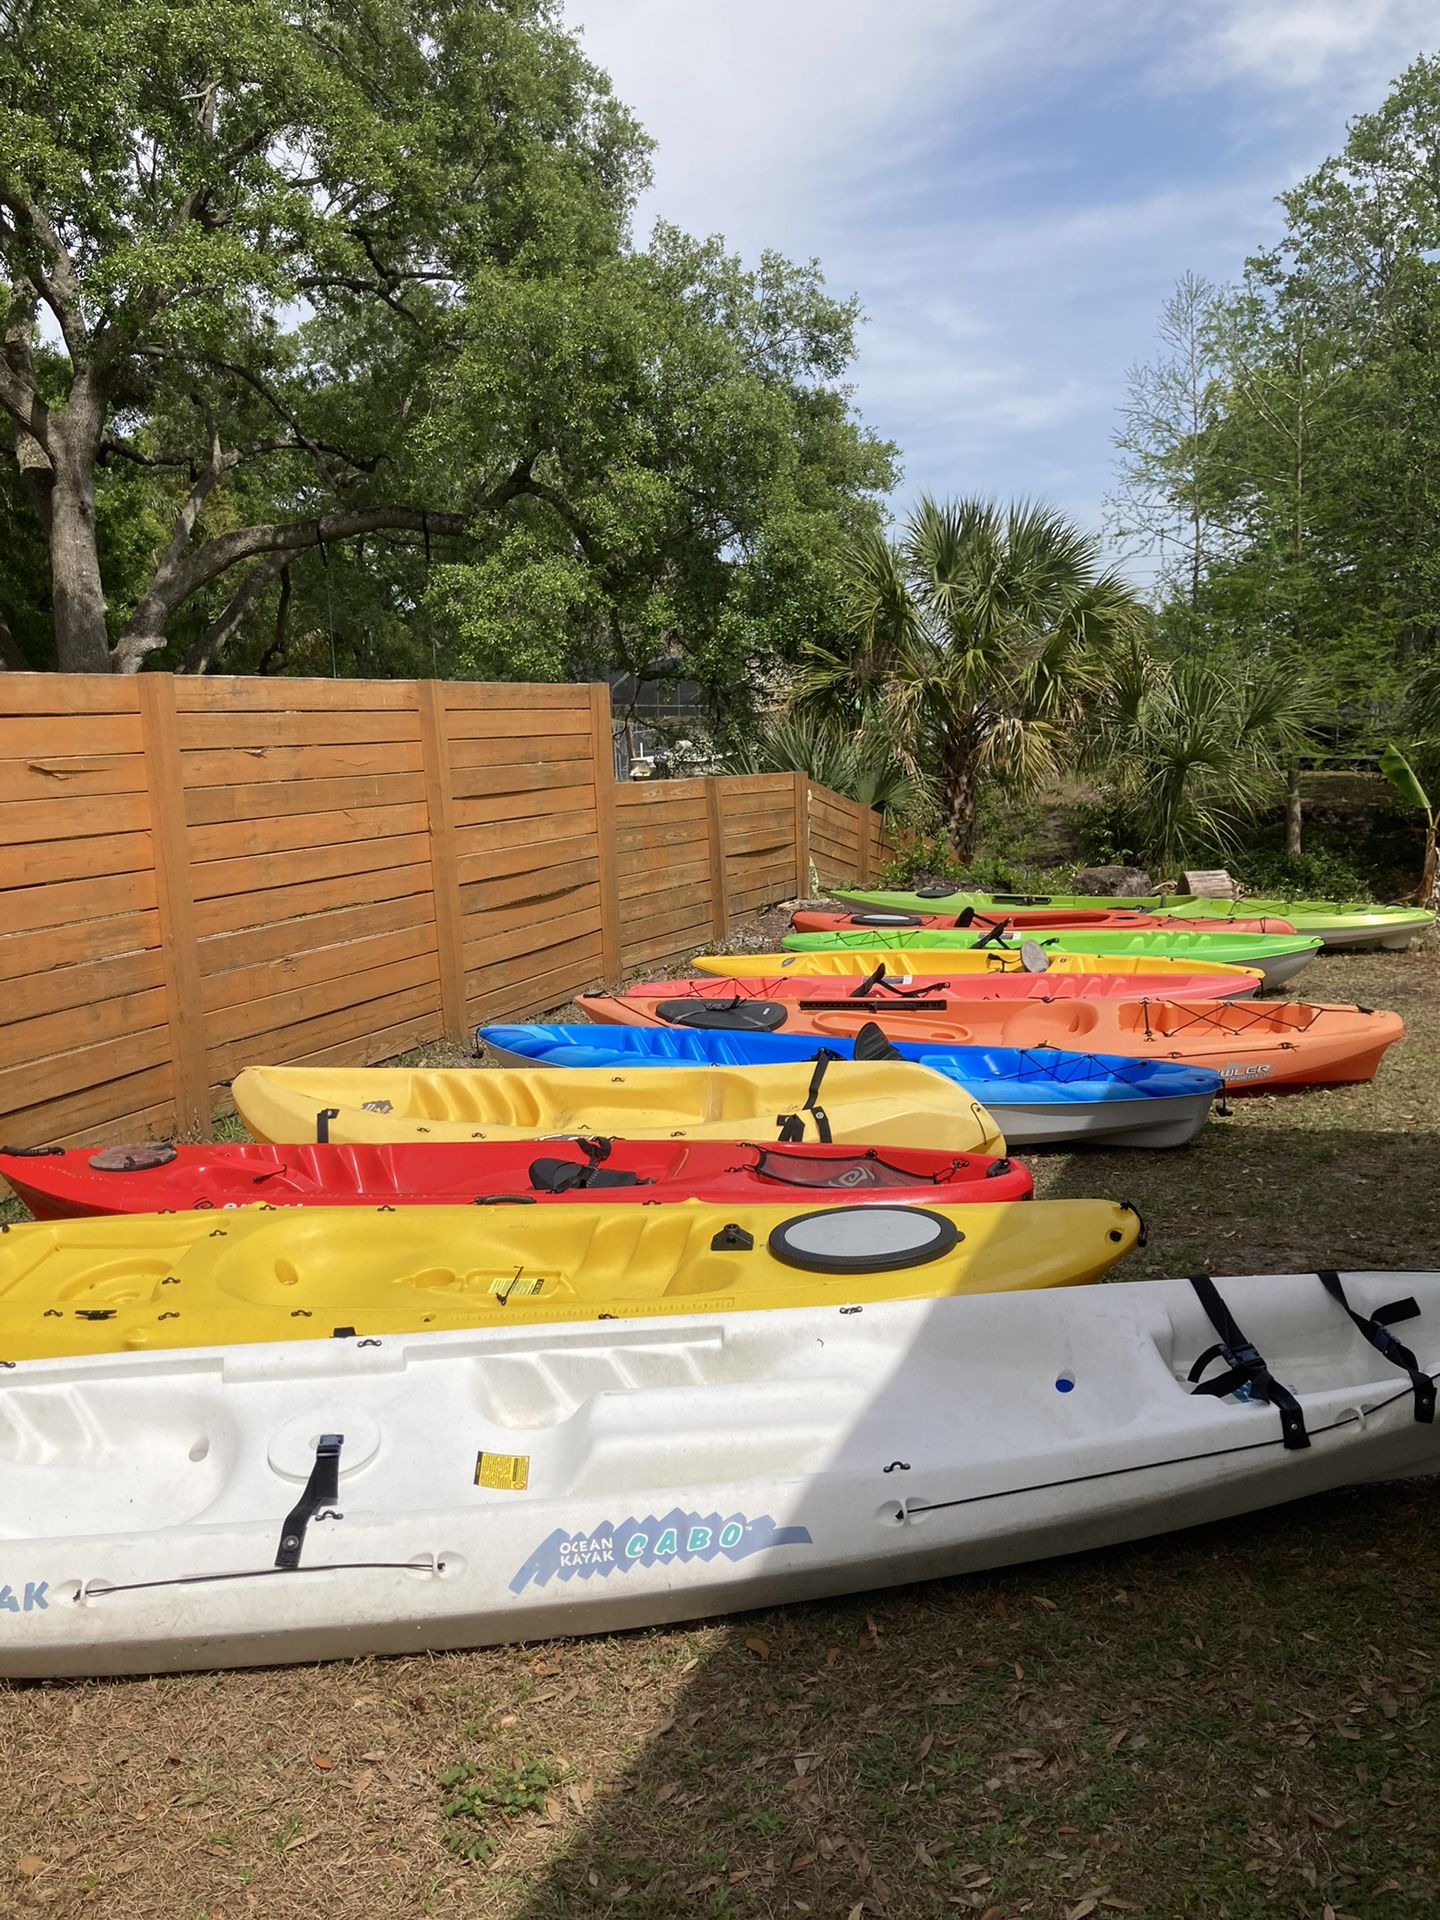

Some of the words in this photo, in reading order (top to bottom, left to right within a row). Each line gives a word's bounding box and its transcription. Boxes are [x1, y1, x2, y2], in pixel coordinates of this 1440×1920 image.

[1218, 1064, 1270, 1077] WLER
[560, 1537, 613, 1554] OCEAN
[625, 1522, 743, 1558] CABO
[560, 1550, 614, 1567] KAYAK
